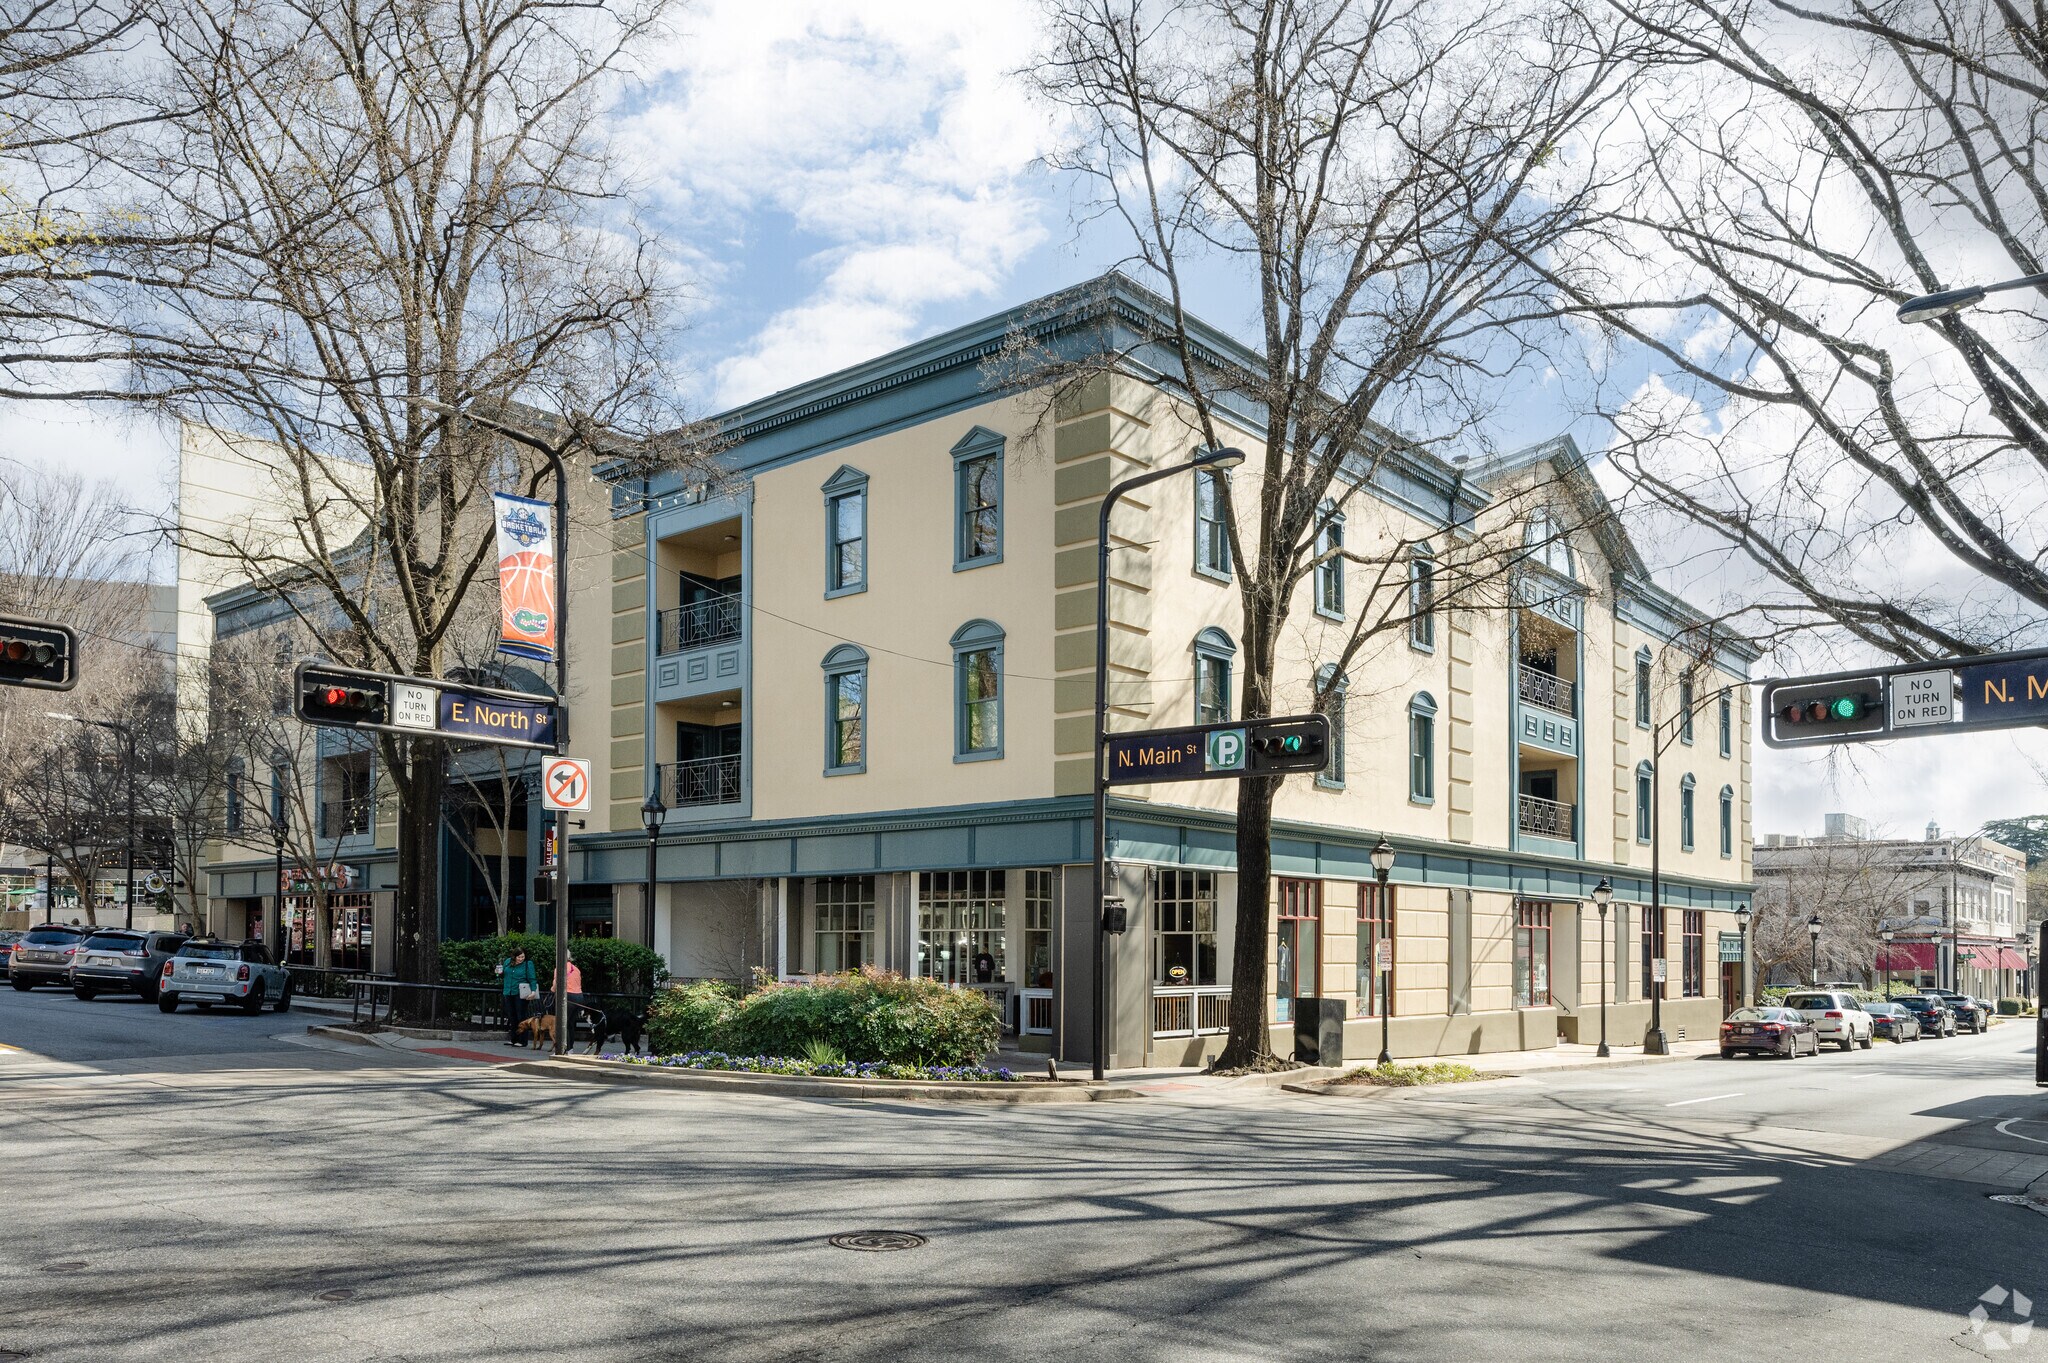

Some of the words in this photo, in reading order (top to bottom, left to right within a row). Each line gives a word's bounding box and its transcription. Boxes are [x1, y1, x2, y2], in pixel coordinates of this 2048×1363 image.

[502, 520, 546, 536] BASKETBALL
[1910, 679, 1933, 691] NO
[1984, 678, 2015, 705] N.
[407, 690, 423, 700] NO
[1905, 692, 1940, 705] TURN
[403, 700, 427, 711] TURN
[1898, 708, 1916, 720] ON
[1922, 705, 1948, 718] RED
[398, 711, 412, 721] ON
[414, 713, 432, 723] RED
[452, 702, 470, 723] E.
[475, 705, 529, 730] North
[535, 713, 547, 725] St
[1118, 749, 1134, 767] N.
[1139, 747, 1182, 766] Main
[1186, 744, 1197, 755] St
[1218, 735, 1239, 765] P
